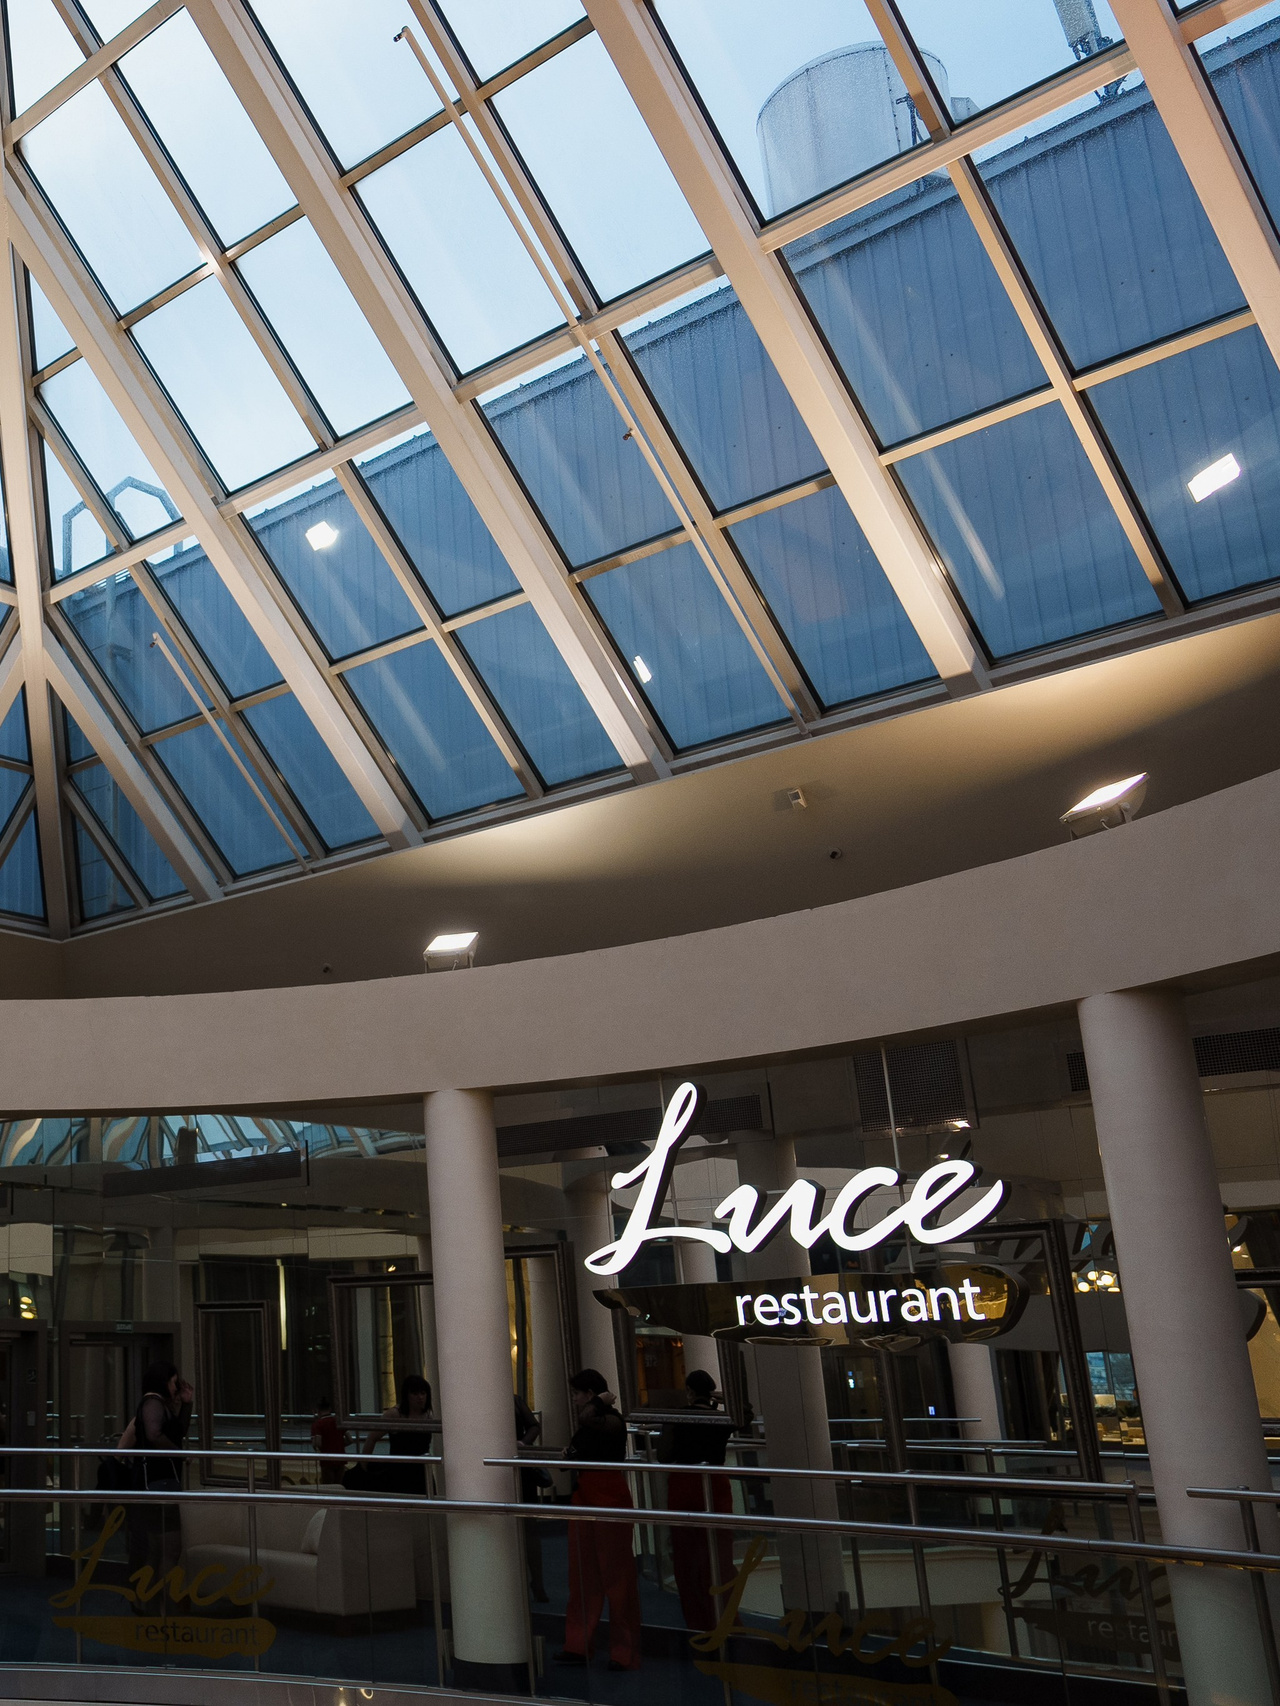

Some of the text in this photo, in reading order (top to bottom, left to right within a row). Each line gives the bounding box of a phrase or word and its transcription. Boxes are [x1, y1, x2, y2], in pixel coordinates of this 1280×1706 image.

[584, 1082, 1004, 1276] Luce
[735, 1278, 985, 1326] restaurant
[49, 1505, 275, 1609] Luce
[689, 1535, 953, 1668] Luce
[135, 1622, 261, 1646] restaurant
